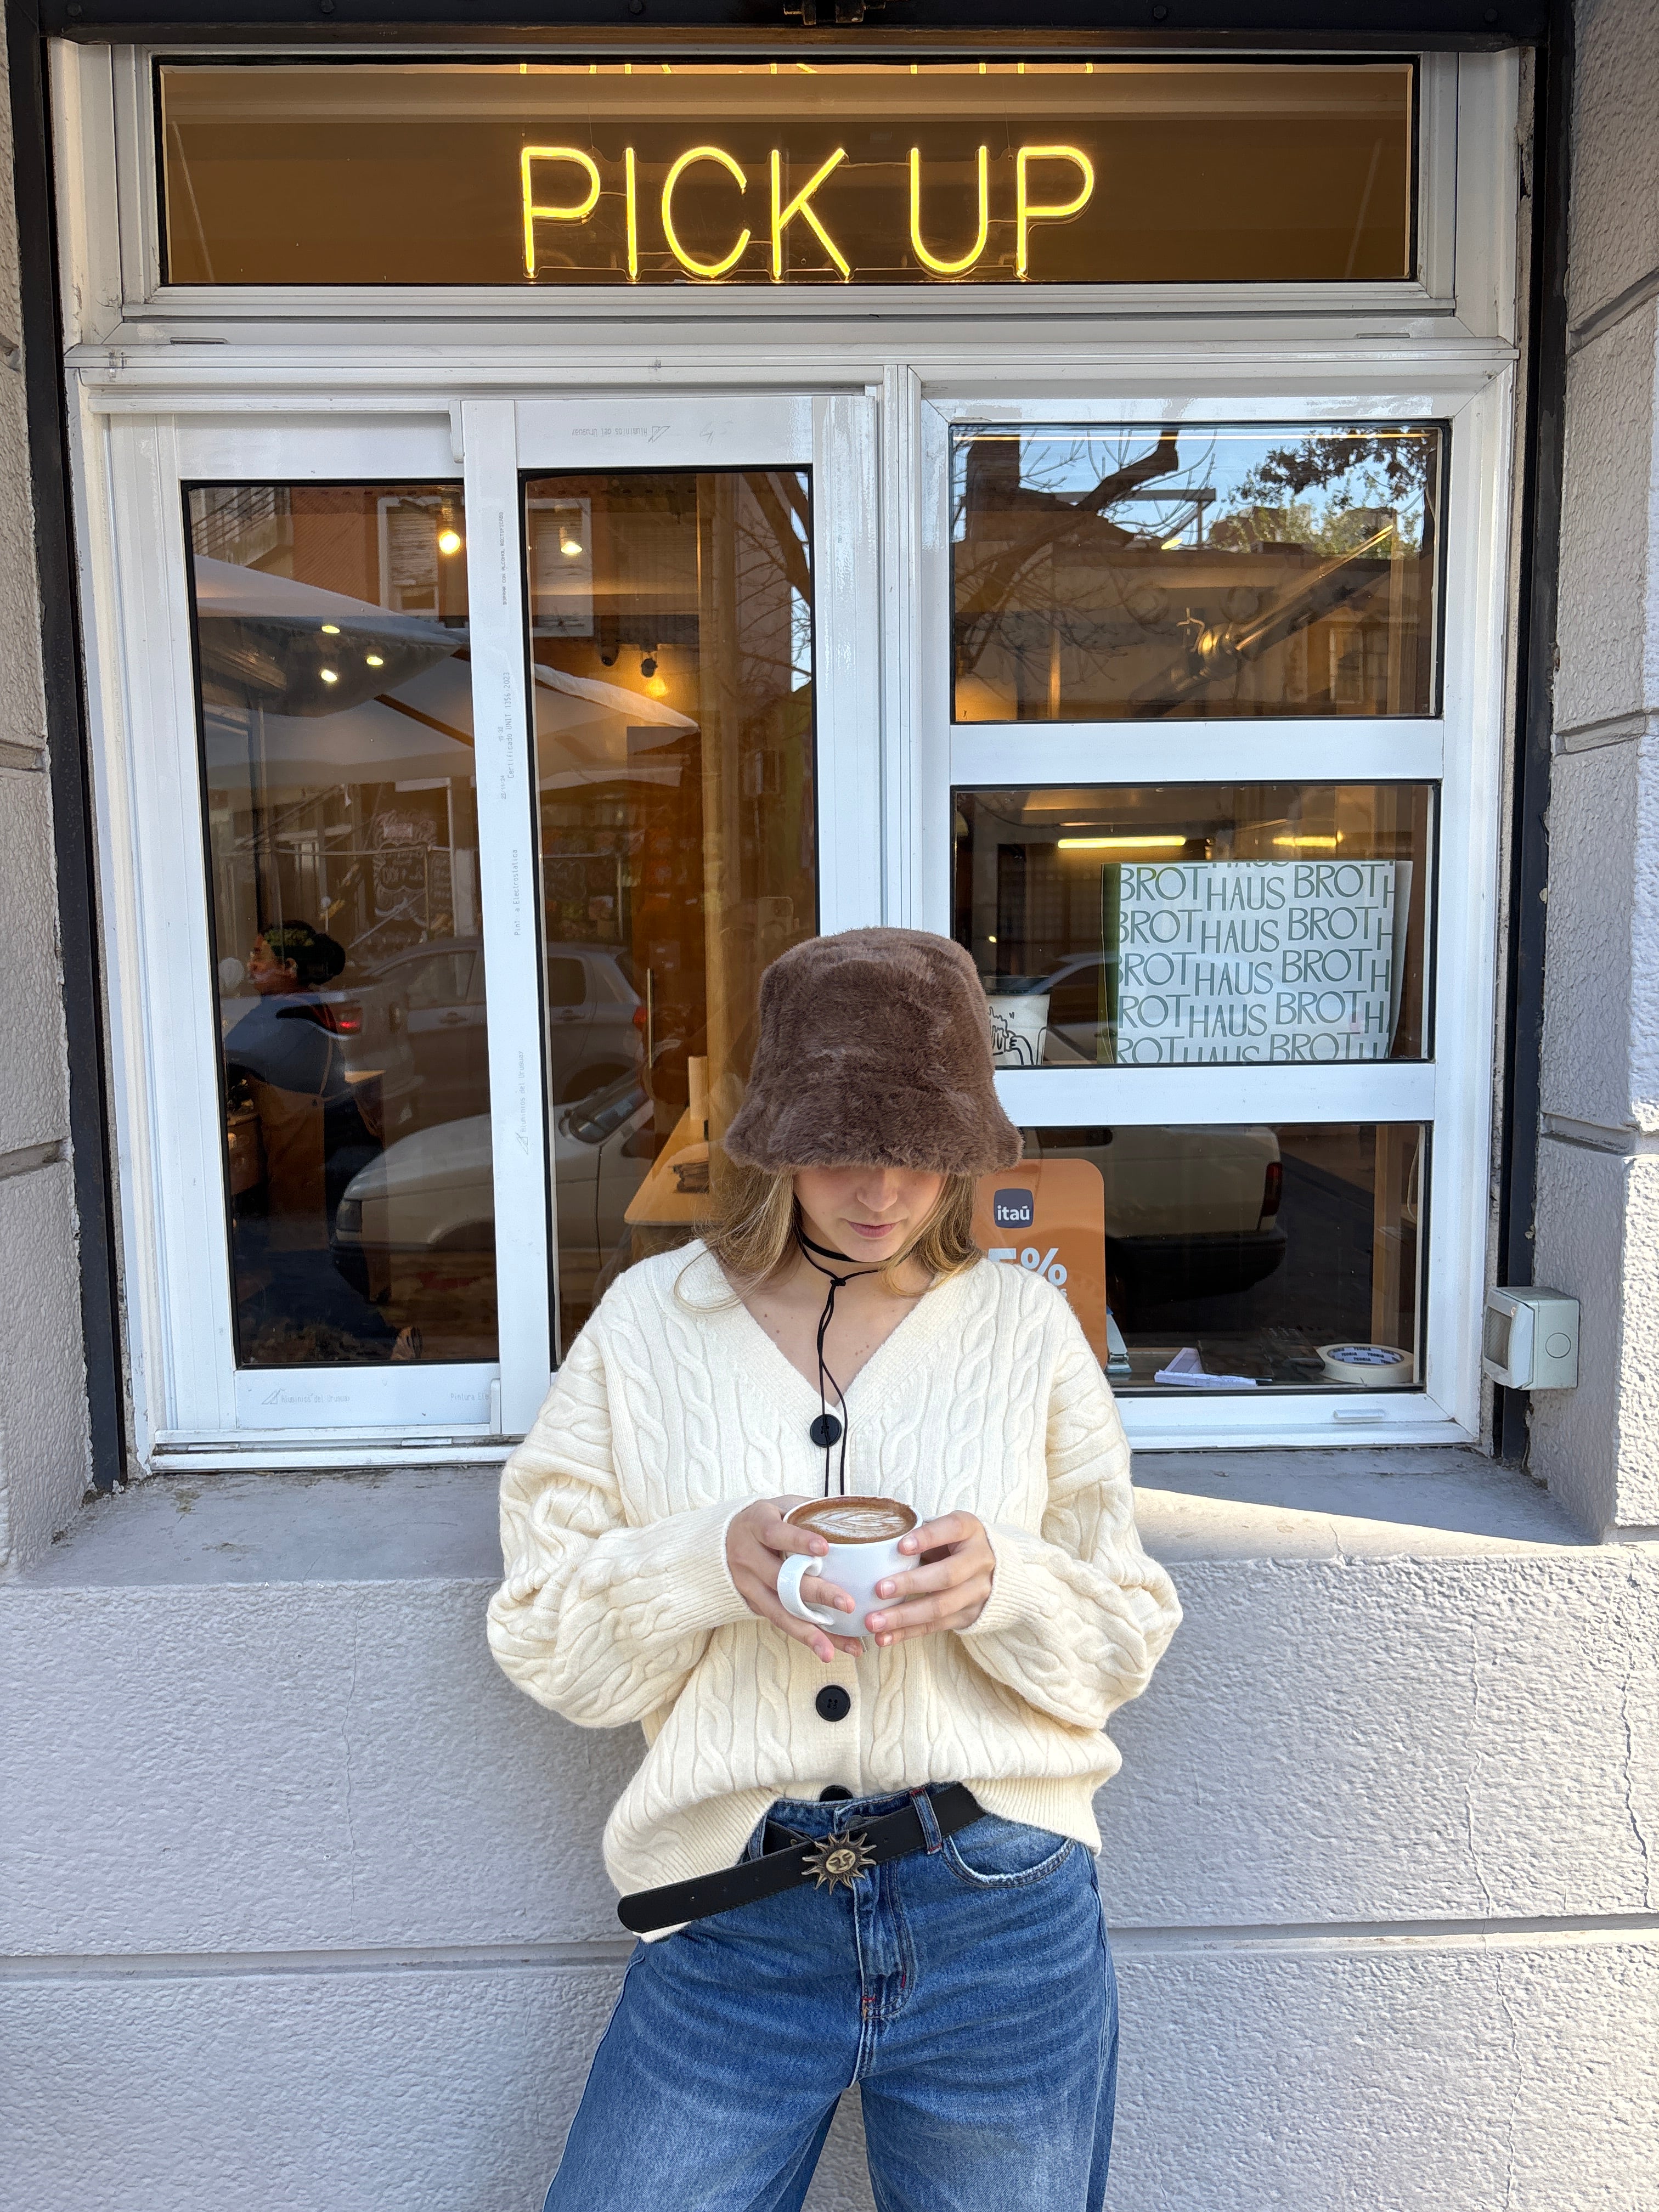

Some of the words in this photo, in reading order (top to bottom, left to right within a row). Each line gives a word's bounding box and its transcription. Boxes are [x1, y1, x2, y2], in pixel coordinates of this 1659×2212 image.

[521, 145, 851, 280] PICK
[910, 145, 1094, 280] UP
[997, 1205, 1030, 1221] itaú
